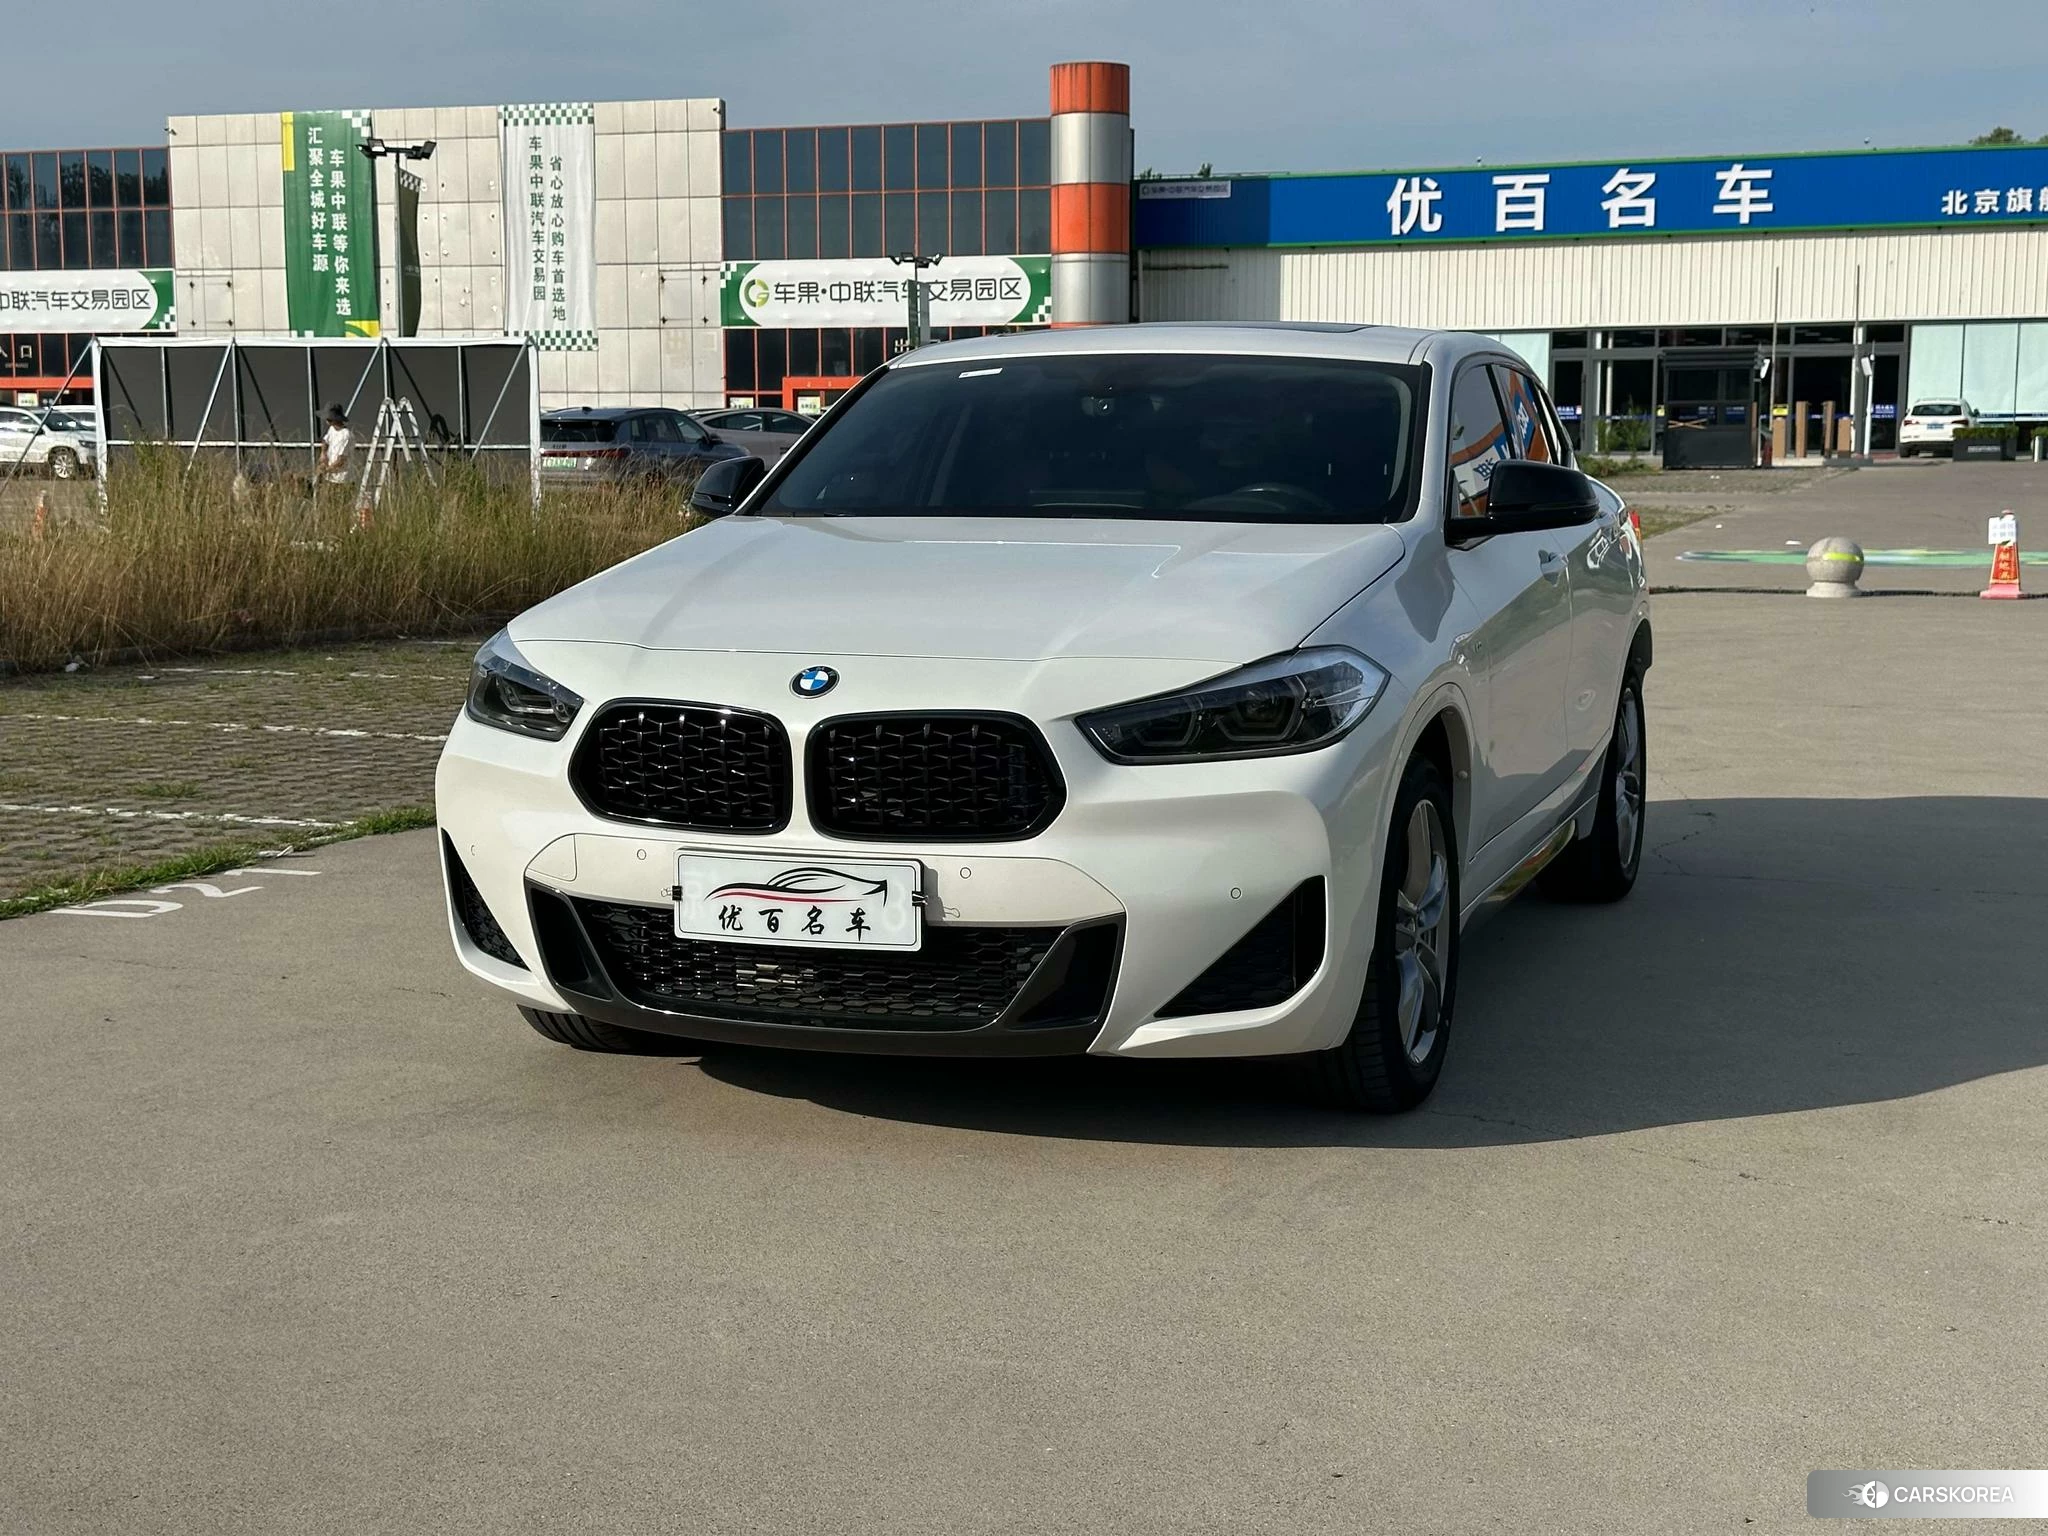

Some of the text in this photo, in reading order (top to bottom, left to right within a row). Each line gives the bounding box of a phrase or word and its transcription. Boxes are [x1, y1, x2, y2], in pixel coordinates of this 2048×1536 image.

[308, 127, 329, 272] 汇聚全城好车源
[329, 149, 352, 316] 车果中联等你来选
[529, 136, 546, 301] 车果中联汽车交易园
[550, 155, 567, 321] 省心放心购车首选地
[1386, 163, 1774, 236] 优百名车
[718, 904, 872, 942] 优百名车
